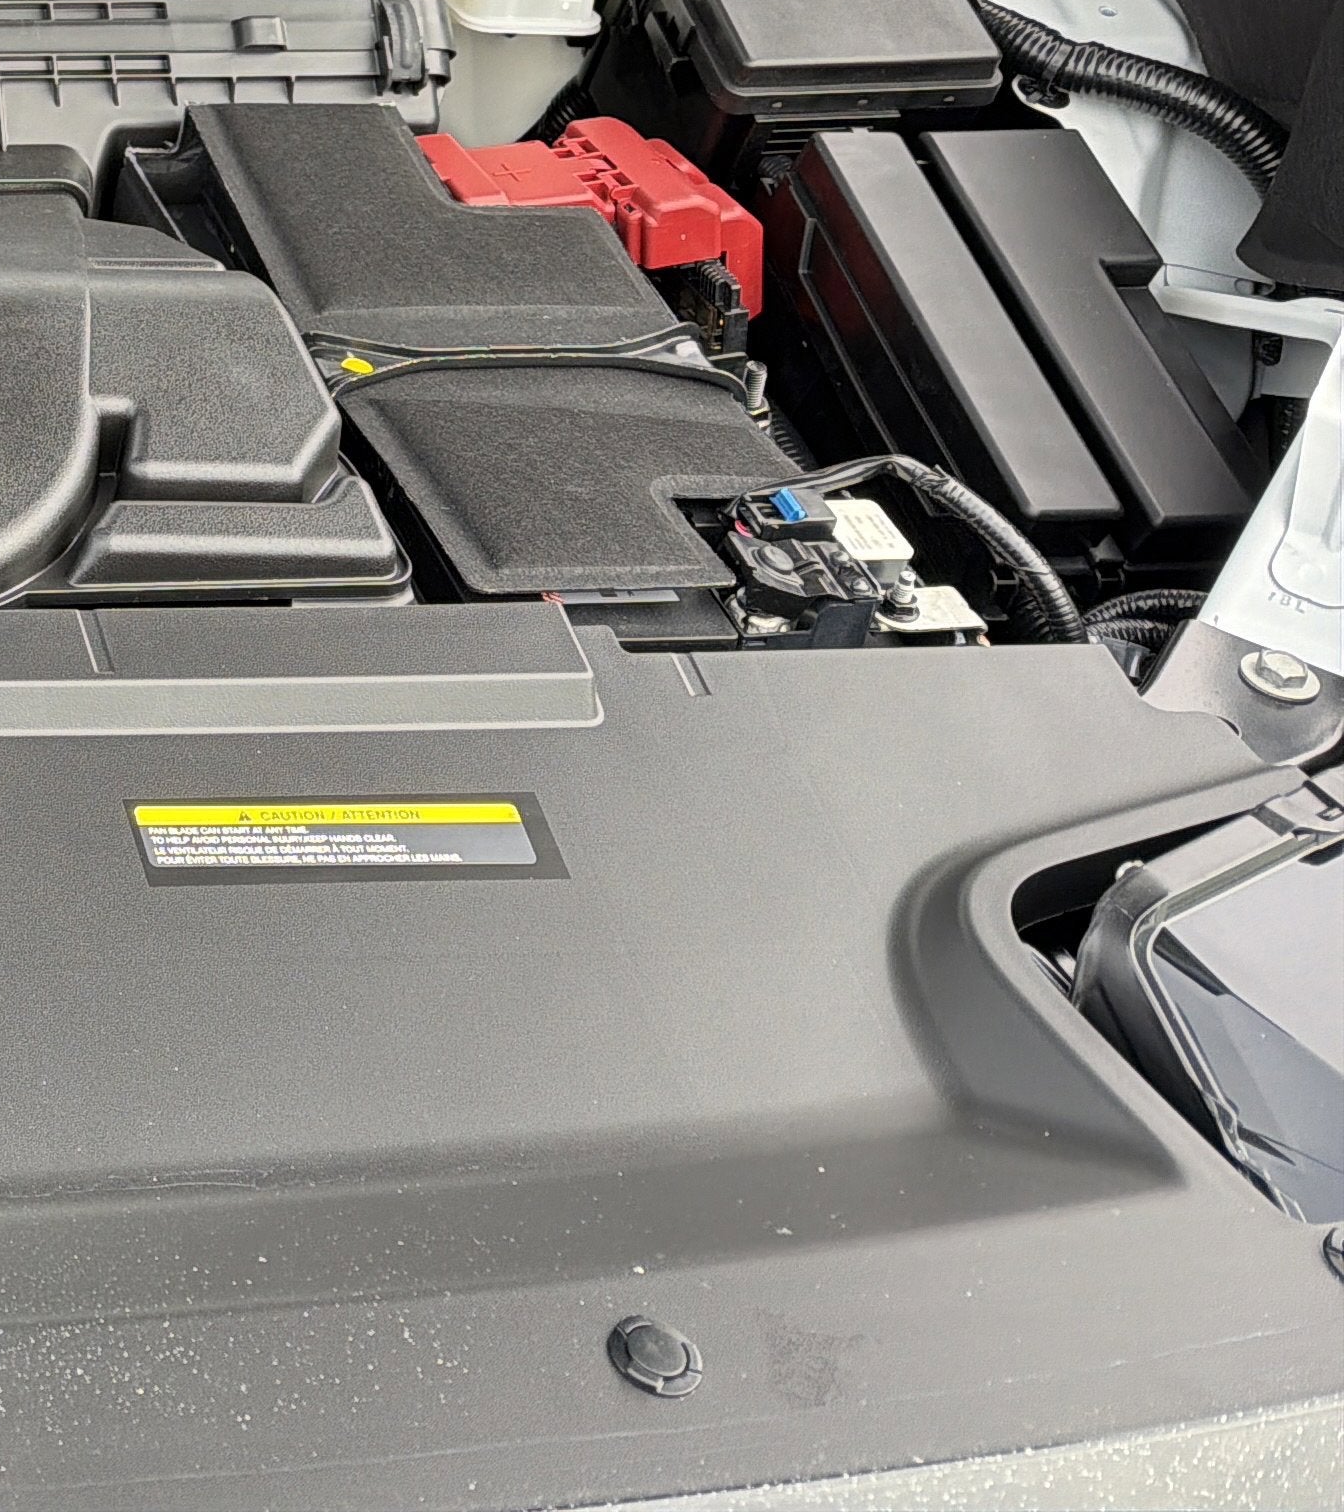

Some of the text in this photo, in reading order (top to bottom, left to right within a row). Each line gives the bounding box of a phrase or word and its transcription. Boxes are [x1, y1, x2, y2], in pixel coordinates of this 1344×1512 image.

[260, 811, 325, 821] CAUTION
[342, 809, 421, 820] ATTENTION
[148, 826, 167, 835] FAN
[168, 826, 199, 835] BLADE
[200, 826, 221, 835] CAN
[222, 826, 250, 835] START
[252, 826, 263, 834] AT
[265, 825, 284, 834] ANY
[151, 836, 164, 845] TO
[165, 836, 191, 844] HELP
[191, 835, 220, 844] AVOID
[221, 835, 272, 844] PERSONAL
[328, 834, 362, 843] HANDS
[153, 846, 166, 855] LE
[265, 845, 278, 854] DE
[340, 844, 365, 853] TOUT
[157, 856, 185, 864] POUR
[218, 855, 250, 864] TOUTE
